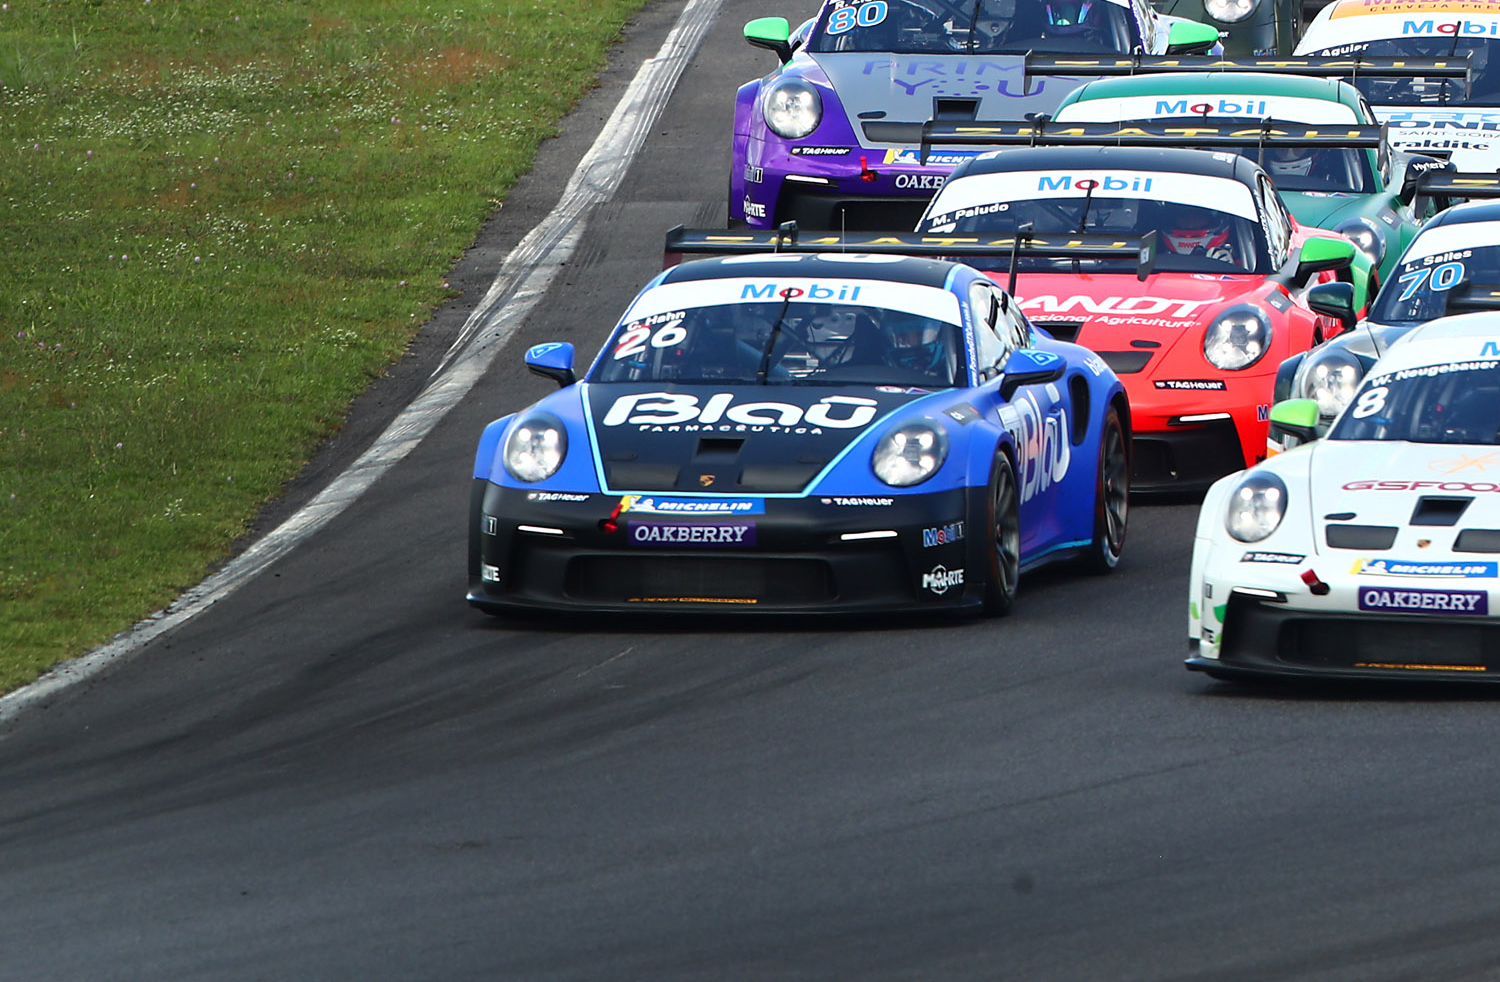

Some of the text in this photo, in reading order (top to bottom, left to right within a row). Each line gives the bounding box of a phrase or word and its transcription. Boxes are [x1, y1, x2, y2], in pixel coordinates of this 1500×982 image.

[1370, 3, 1450, 12] CERVEJA
[826, 0, 888, 35] 80
[863, 60, 1025, 75] PRIM
[1155, 100, 1266, 116] Mobil
[1393, 139, 1490, 151] raldite
[1037, 175, 1153, 193] Mobil
[932, 202, 1009, 227] M. Paludo
[1423, 248, 1472, 266] Salles
[1398, 261, 1466, 302] 70
[740, 284, 861, 301] Mobil
[626, 311, 686, 332] C. Hahn
[613, 319, 688, 361] 26
[1372, 360, 1499, 387] W. Neugebauer
[1352, 387, 1389, 419] 8
[657, 501, 753, 511] MICHELIN
[634, 525, 749, 543] OAKBERRY
[923, 527, 953, 548] Mobil
[1389, 563, 1487, 576] MICHELIN
[1364, 591, 1481, 611] OAKBERRY
